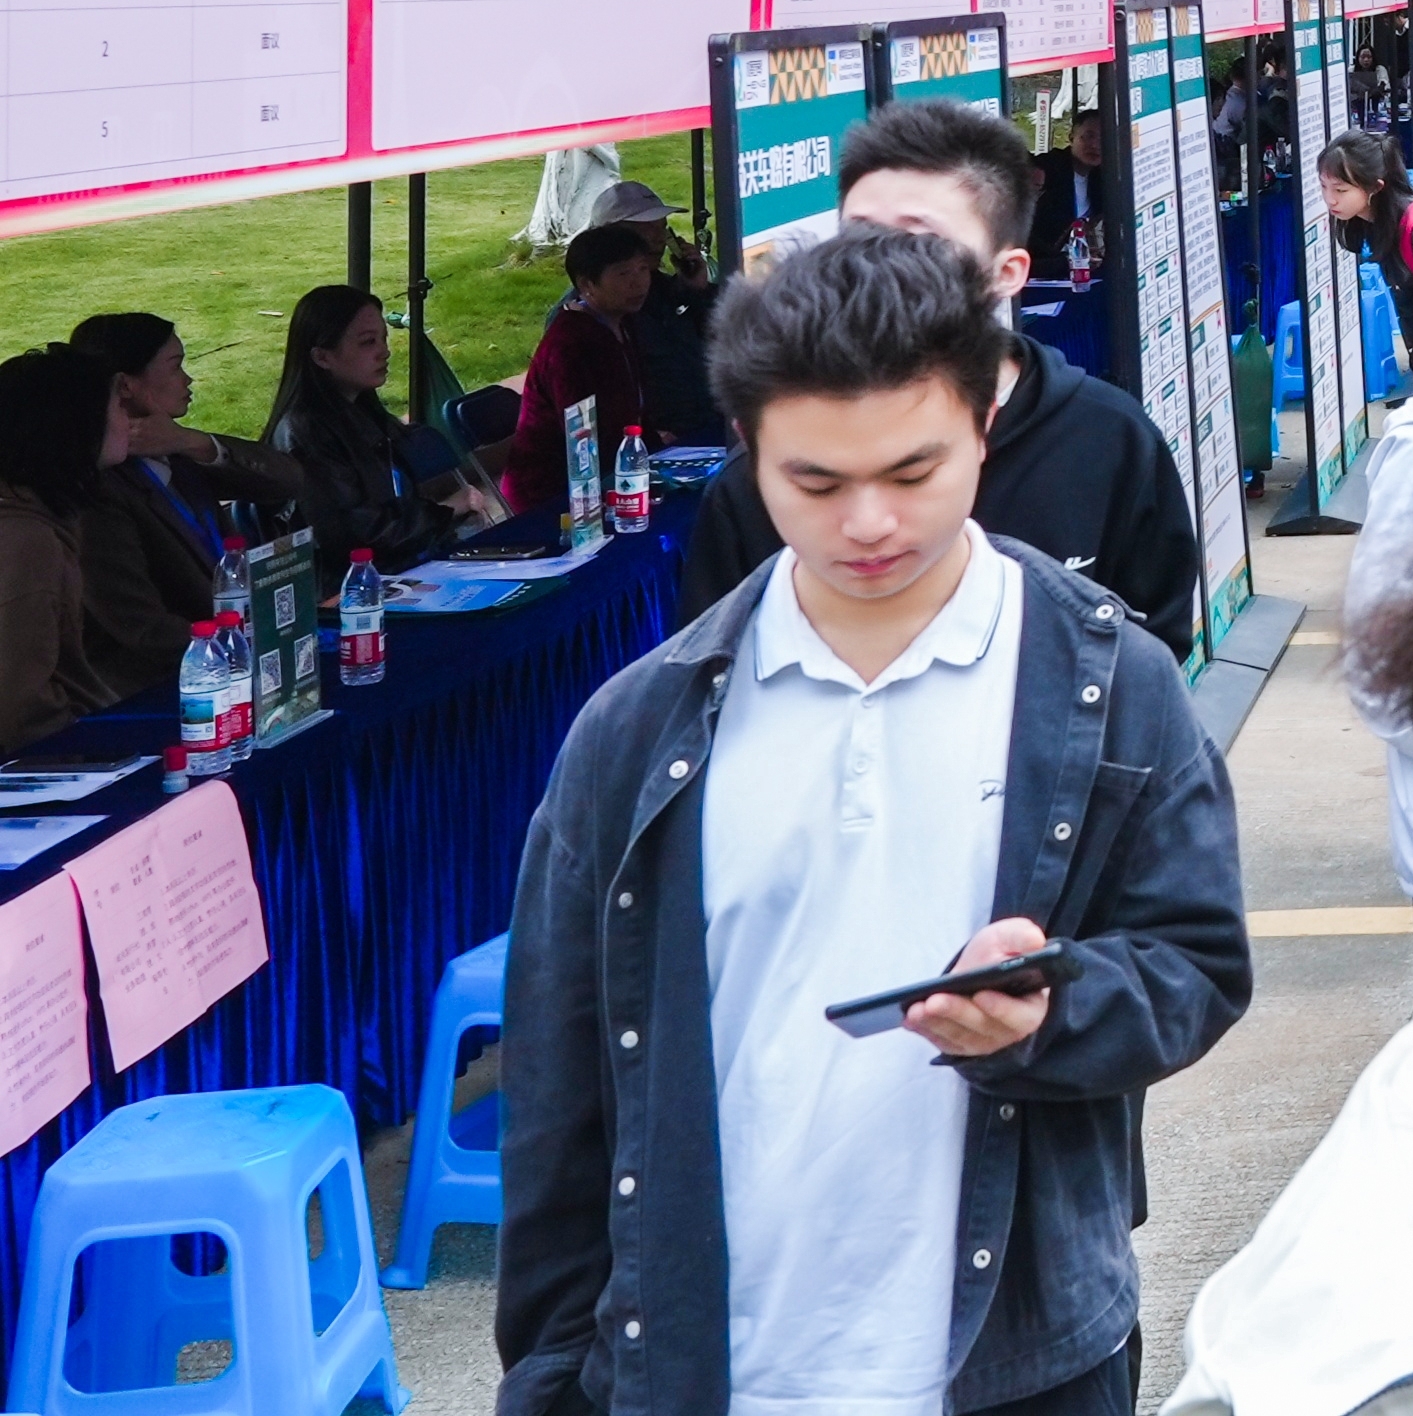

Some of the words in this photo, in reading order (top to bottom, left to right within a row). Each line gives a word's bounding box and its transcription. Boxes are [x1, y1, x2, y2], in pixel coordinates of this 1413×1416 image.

[101, 40, 109, 58] 2
[260, 32, 281, 50] 面议
[101, 120, 109, 138] 5
[260, 104, 281, 123] 面议
